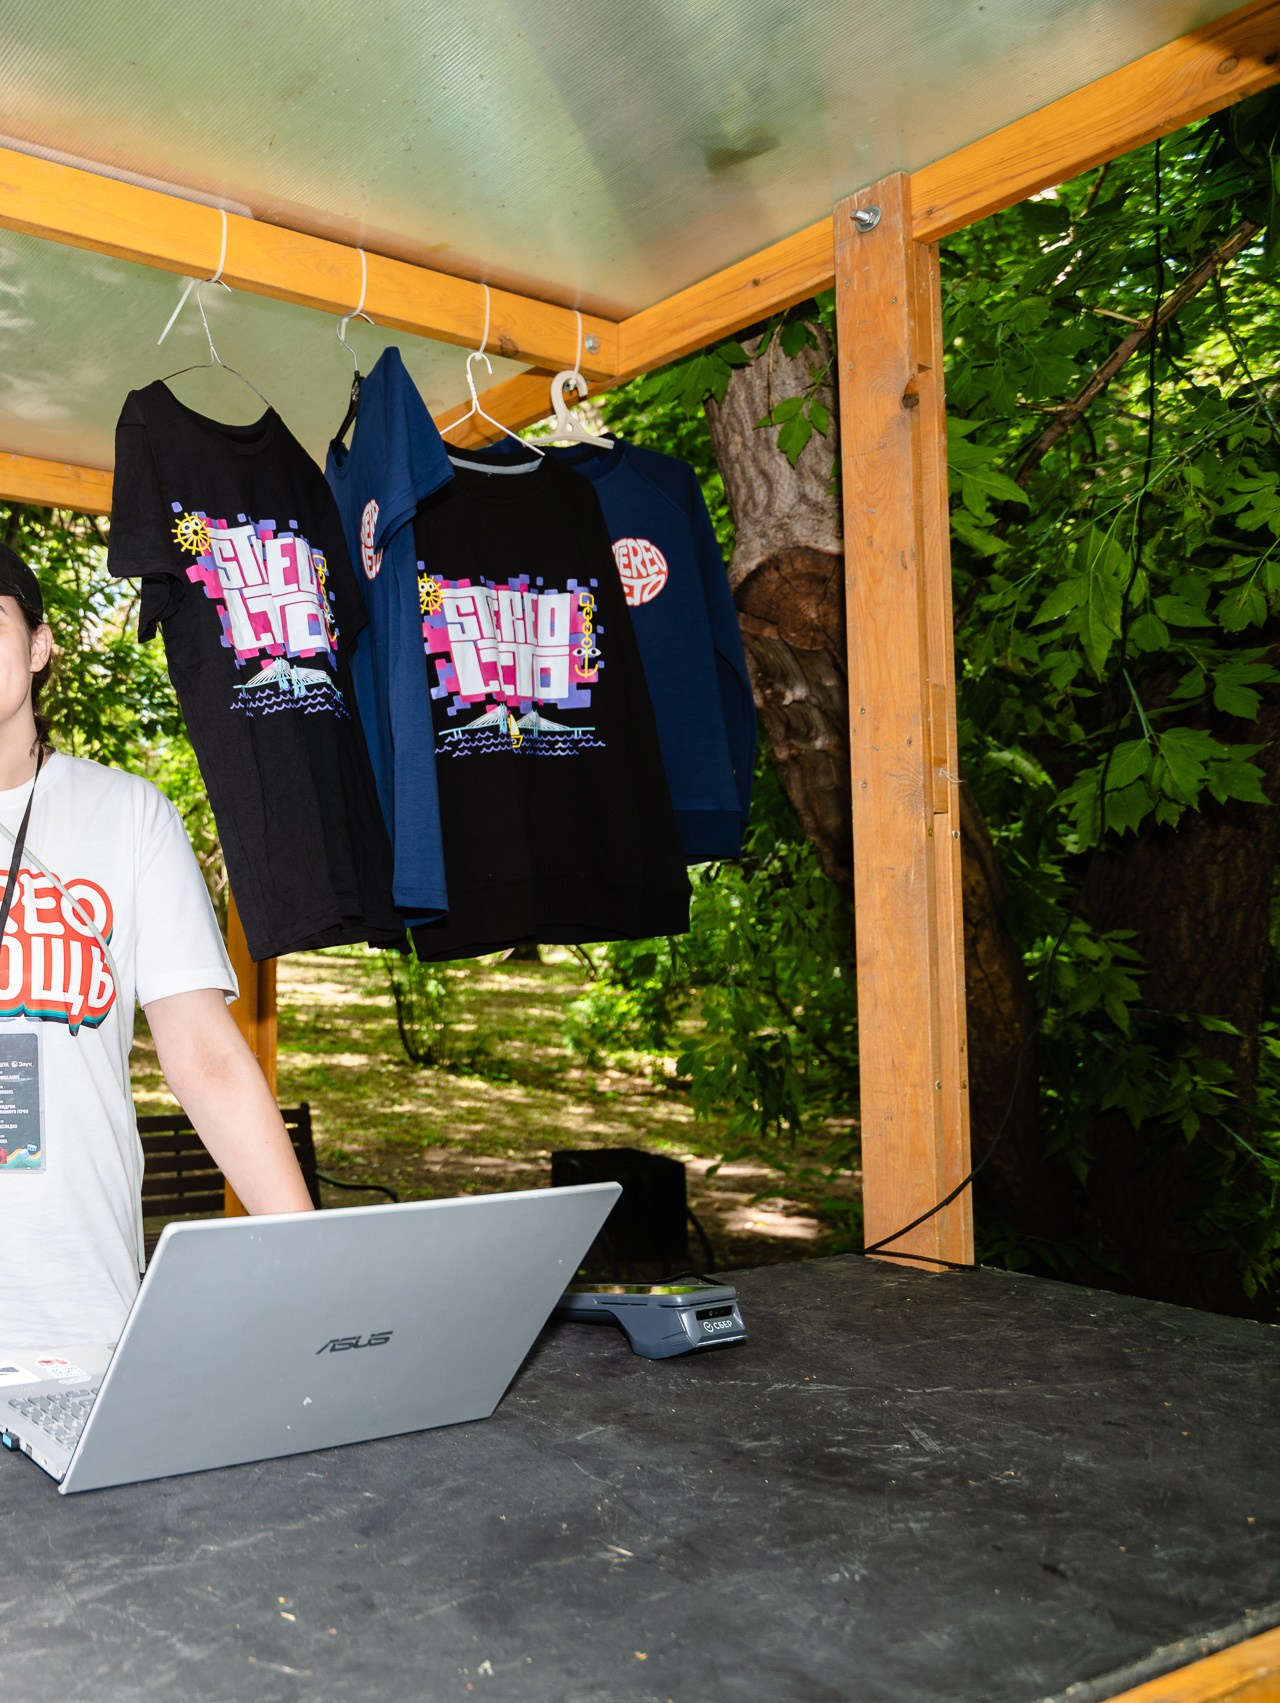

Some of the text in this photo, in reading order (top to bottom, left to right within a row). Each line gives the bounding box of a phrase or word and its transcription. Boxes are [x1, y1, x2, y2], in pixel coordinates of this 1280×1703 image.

[612, 538, 667, 579] TEREO
[713, 1320, 732, 1330] СБЕР
[315, 1330, 394, 1355] ASUS
